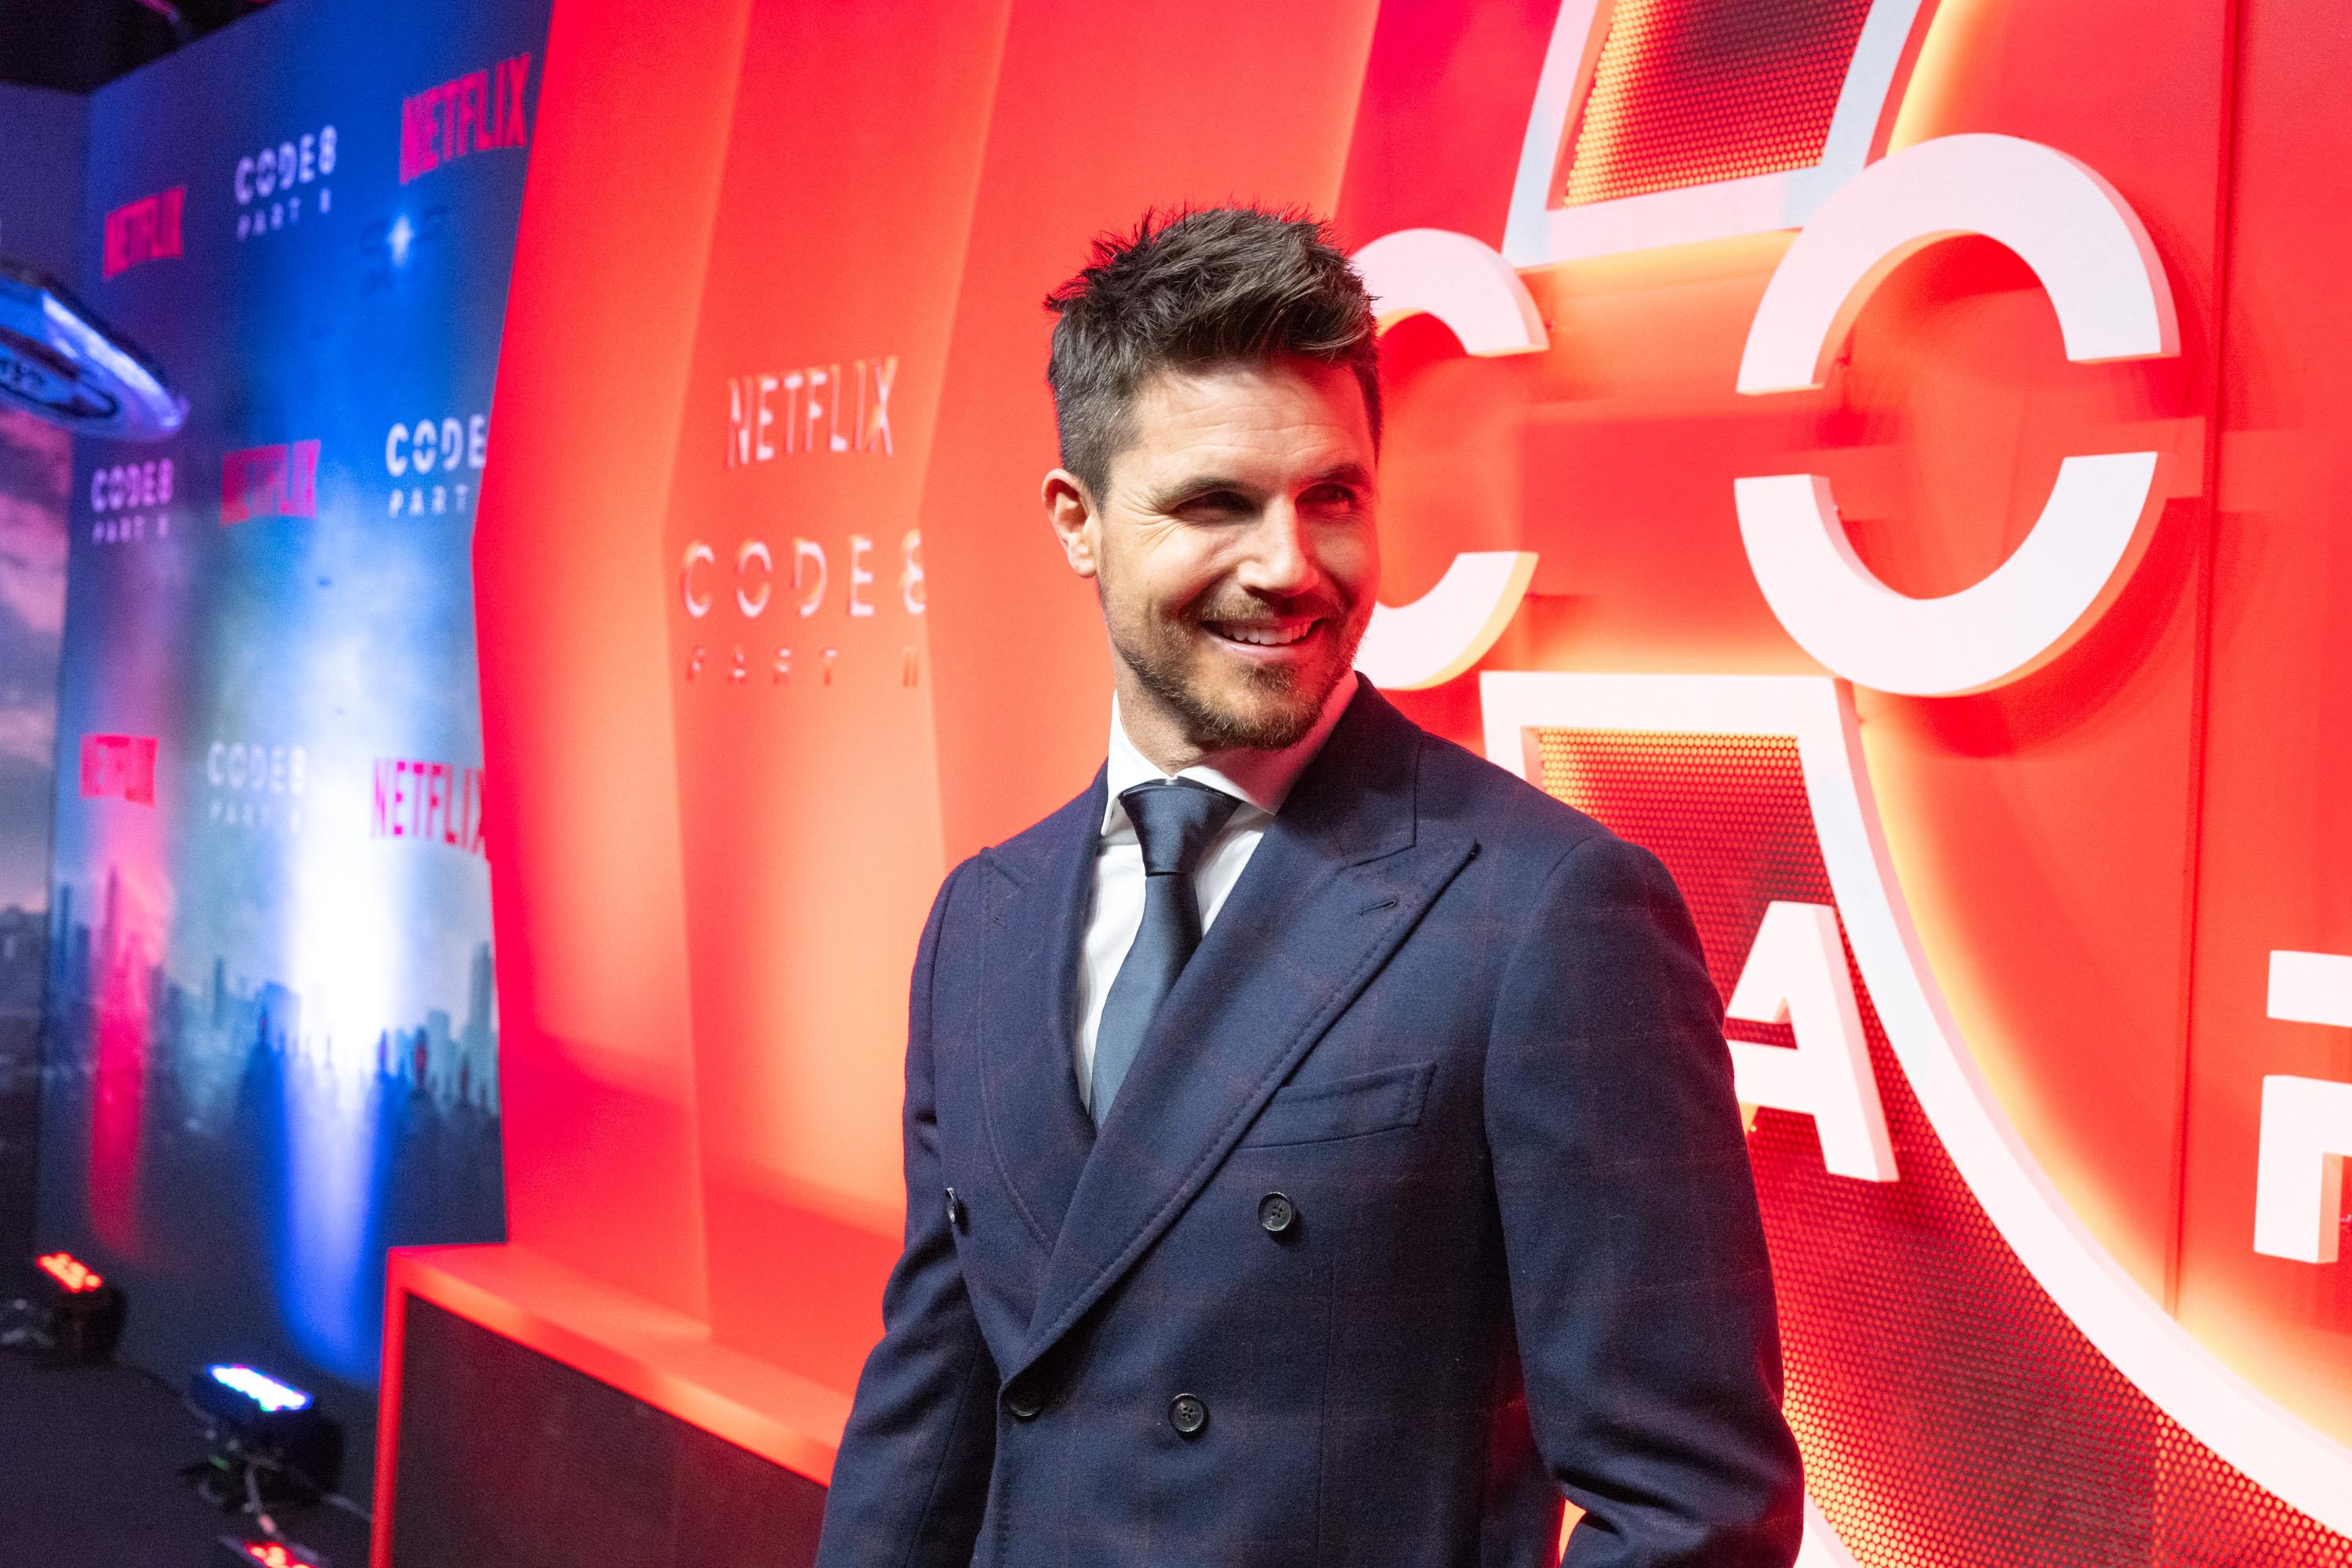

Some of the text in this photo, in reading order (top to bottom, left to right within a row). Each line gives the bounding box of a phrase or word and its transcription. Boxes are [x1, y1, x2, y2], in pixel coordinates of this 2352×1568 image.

[399, 53, 530, 185] NETFLIX
[727, 354, 899, 469] NETFLIX
[387, 484, 469, 517] PART
